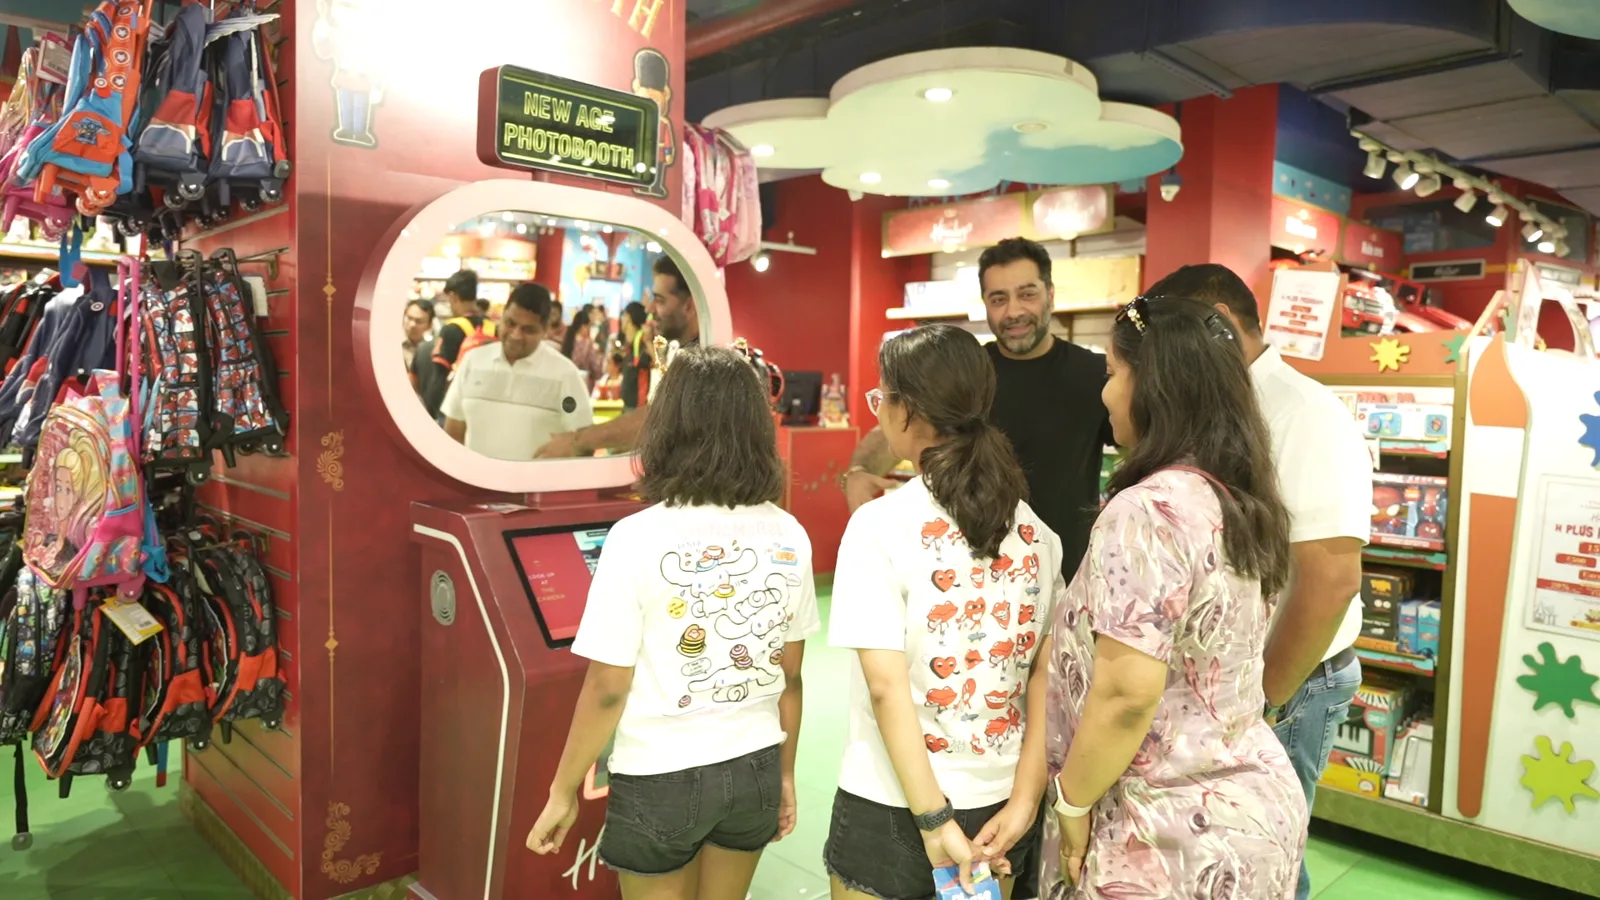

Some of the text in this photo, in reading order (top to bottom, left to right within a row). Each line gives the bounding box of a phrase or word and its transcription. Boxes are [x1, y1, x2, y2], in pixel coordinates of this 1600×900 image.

[523, 91, 615, 133] NEW AGE
[503, 122, 635, 171] PHOTOBOOTH
[1566, 524, 1594, 539] PLUS
[528, 572, 545, 580] LOOK
